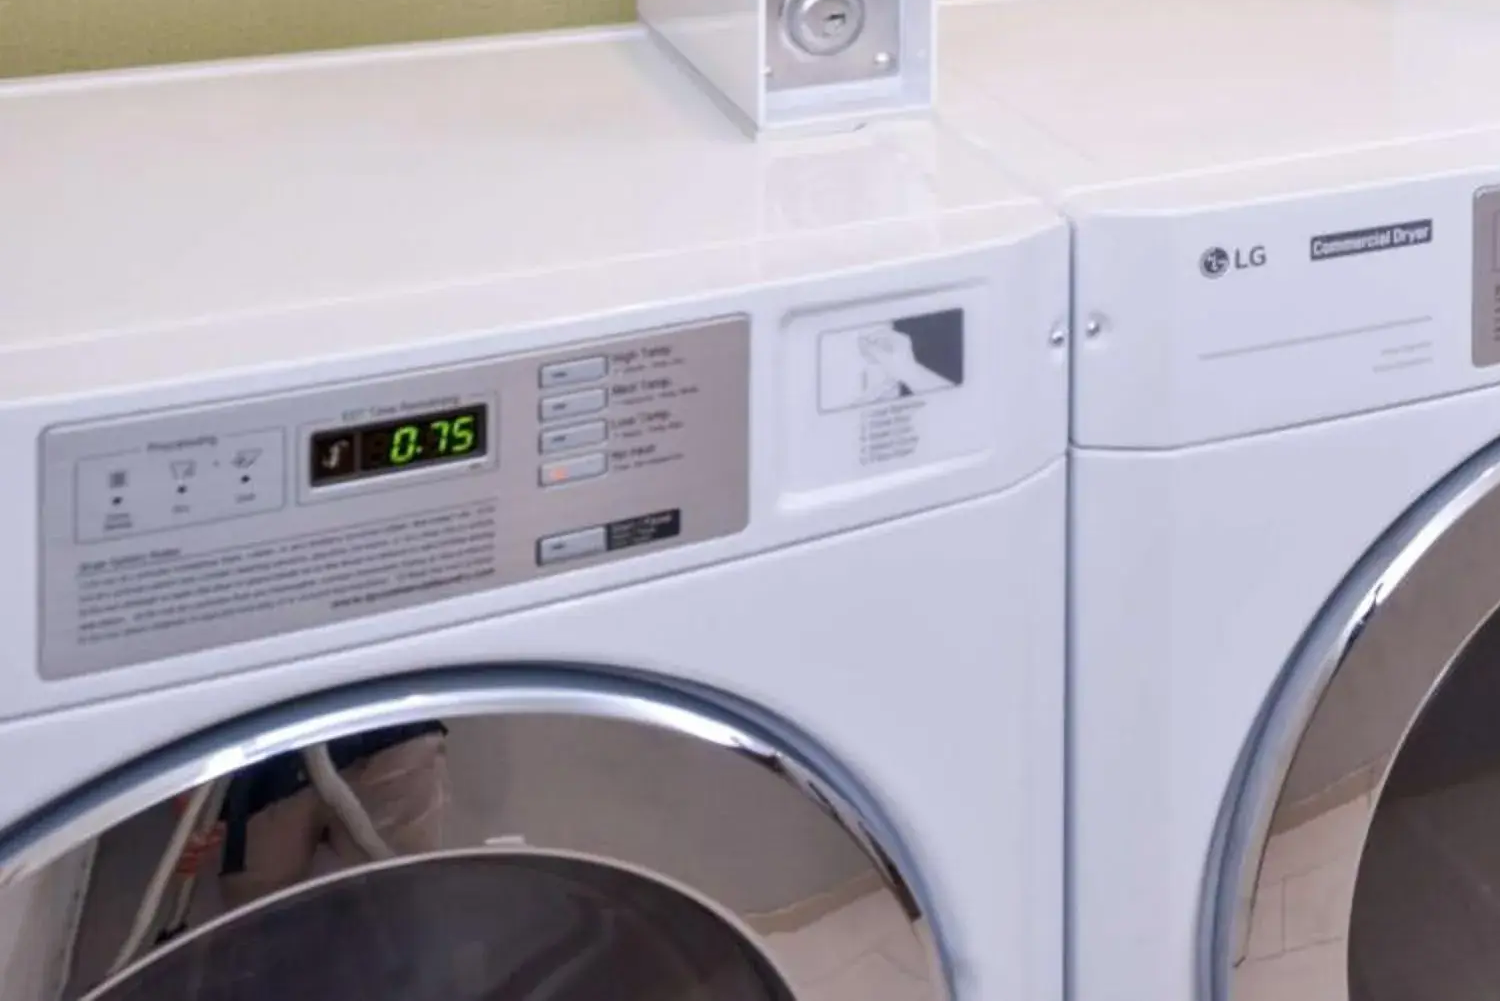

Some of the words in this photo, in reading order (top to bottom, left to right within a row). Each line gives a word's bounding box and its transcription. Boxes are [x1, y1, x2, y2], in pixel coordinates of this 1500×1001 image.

[1234, 245, 1267, 270] LG
[1313, 229, 1391, 257] Commercial
[1394, 225, 1430, 245] Dryer
[389, 415, 475, 466] 0.75
